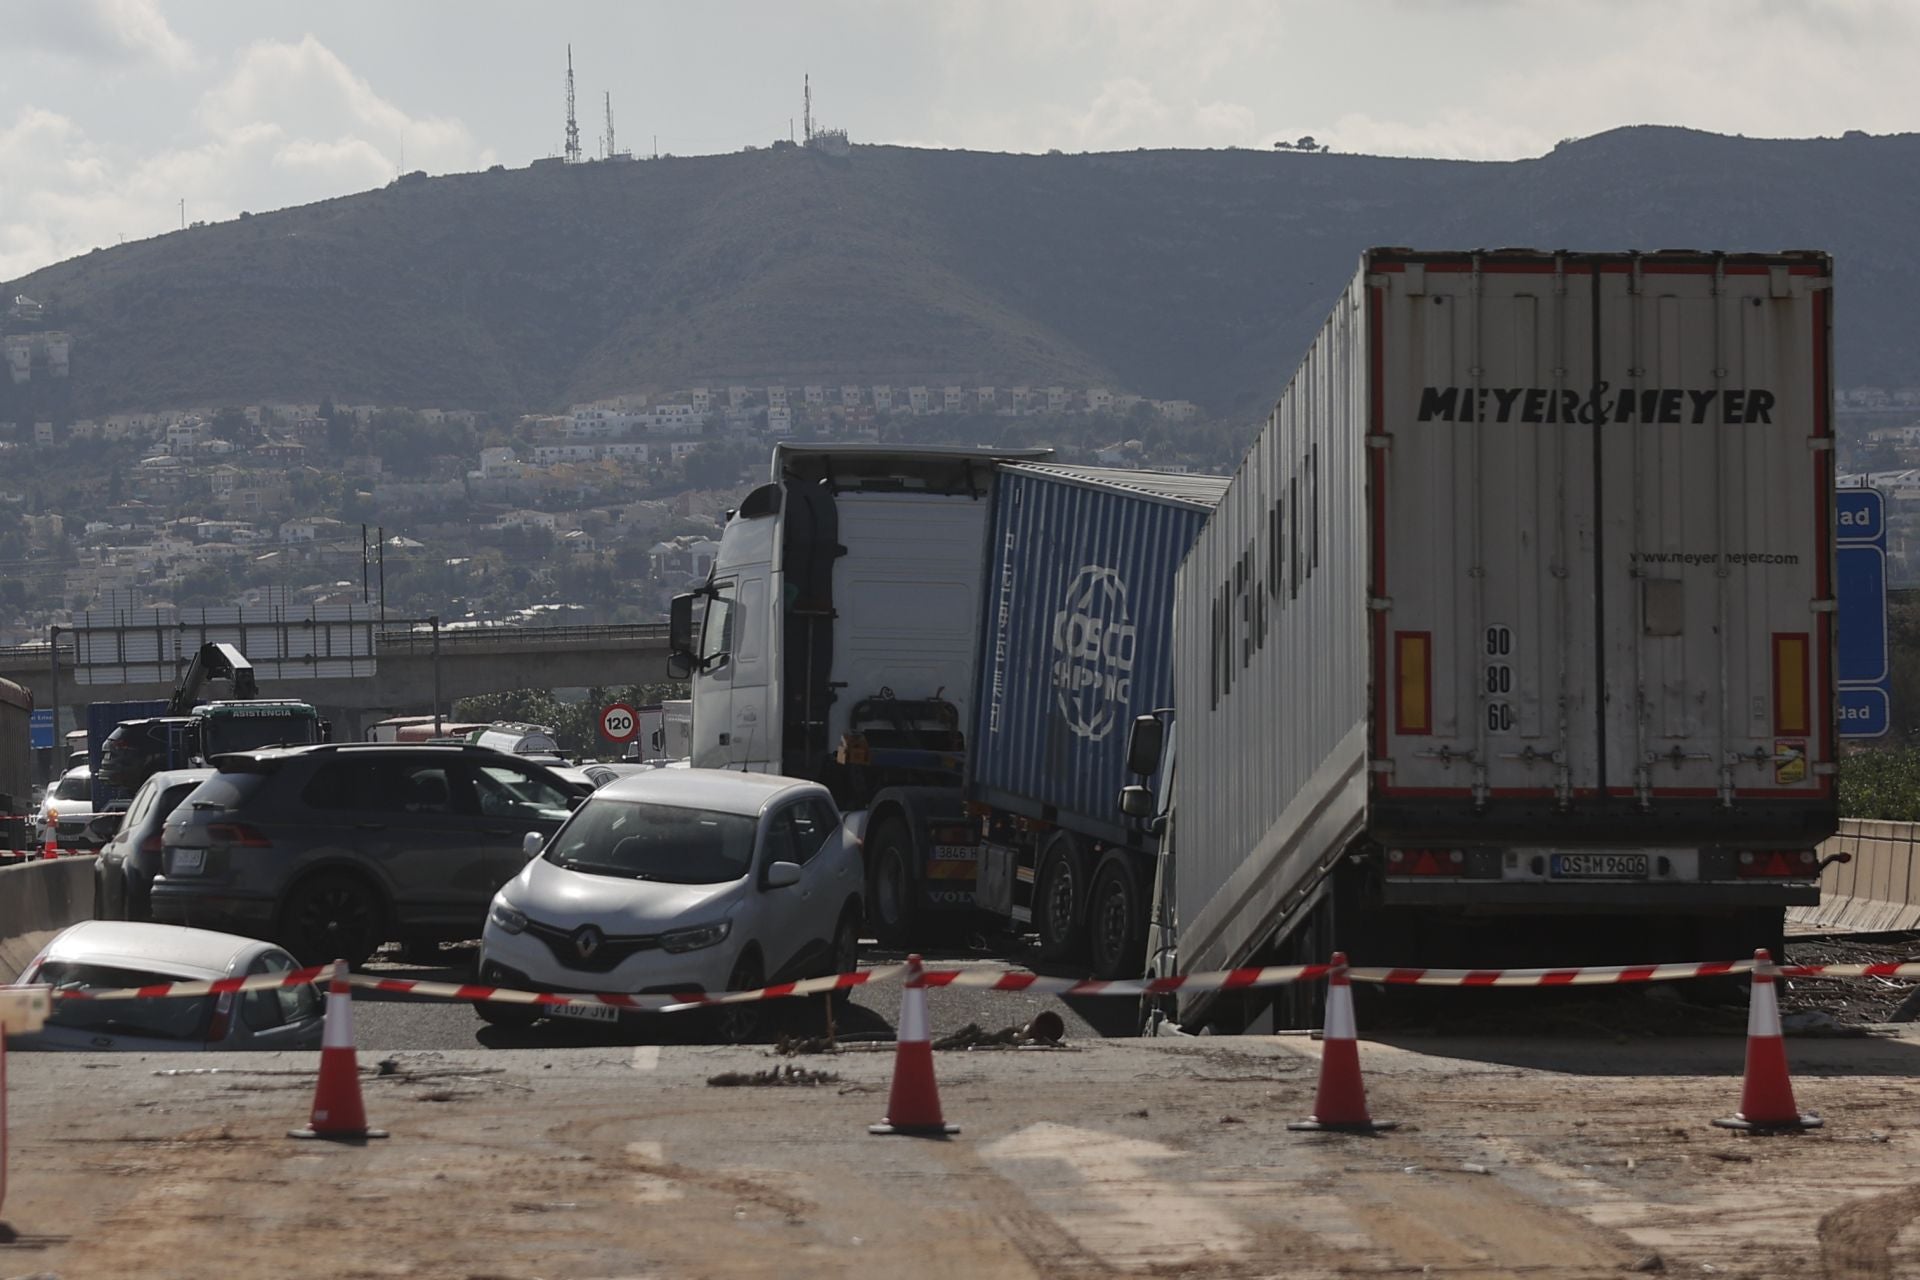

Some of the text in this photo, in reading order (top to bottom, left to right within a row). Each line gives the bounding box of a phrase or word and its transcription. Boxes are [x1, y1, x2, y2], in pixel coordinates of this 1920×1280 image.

[1418, 382, 1775, 425] MEYER&MEYER
[1052, 610, 1137, 672] COSCO
[1486, 628, 1510, 655] 90
[1053, 661, 1132, 705] SHIPPNG
[1487, 666, 1510, 693] 80
[232, 709, 292, 719] ASISTENCIA
[606, 716, 632, 730] 120
[1488, 704, 1511, 731] 60
[939, 847, 966, 858] 3846
[1562, 856, 1646, 874] OS M 9606
